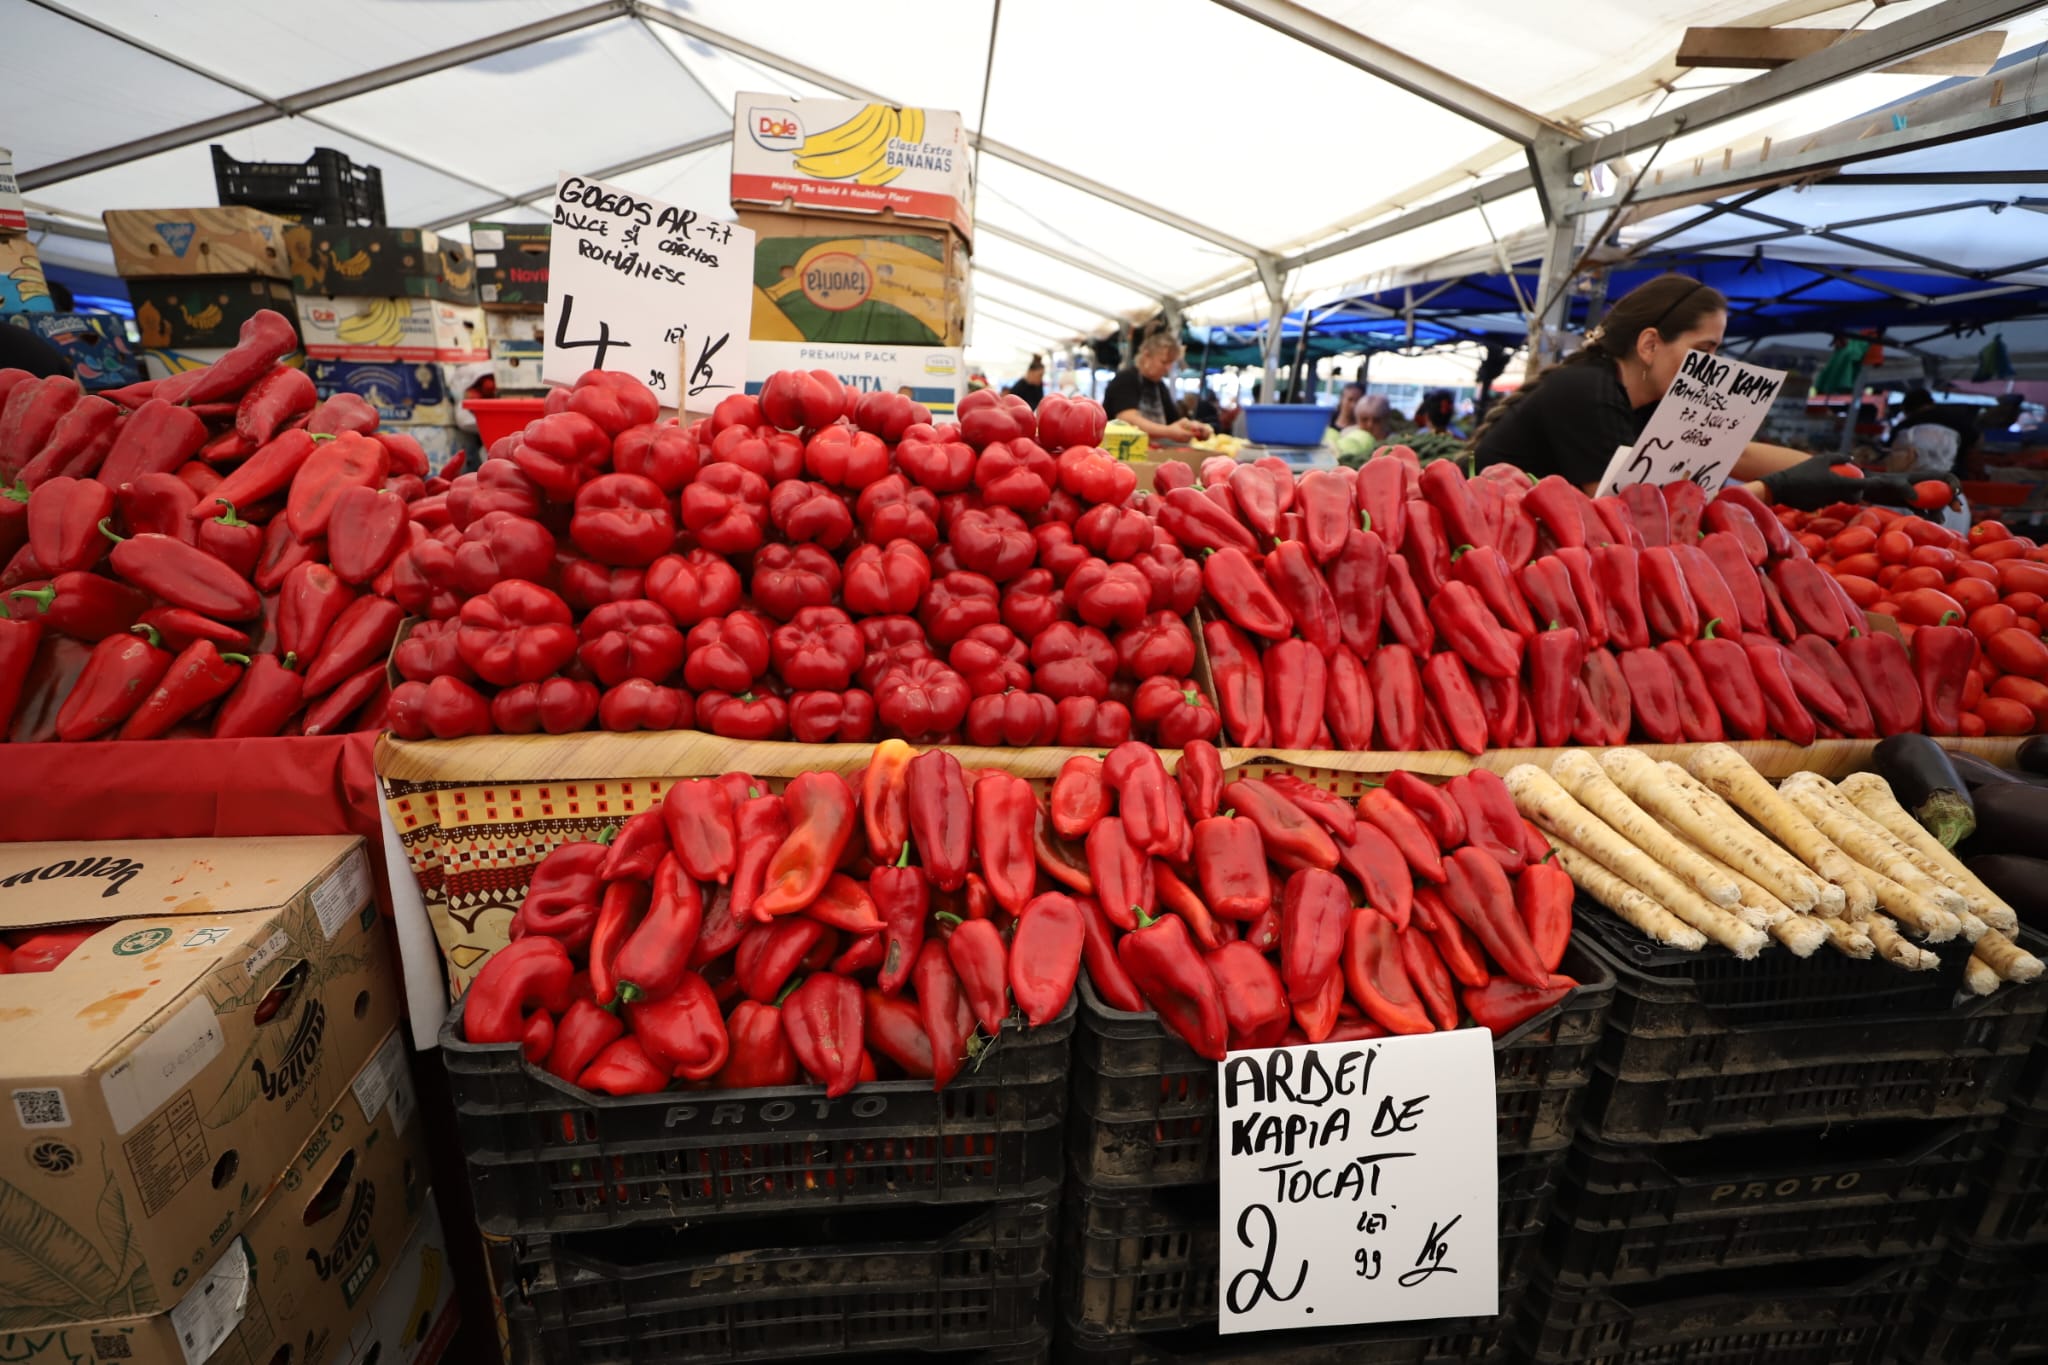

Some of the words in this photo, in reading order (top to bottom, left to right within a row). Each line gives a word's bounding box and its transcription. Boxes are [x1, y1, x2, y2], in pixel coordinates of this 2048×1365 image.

[760, 117, 797, 136] Dole
[887, 151, 952, 172] BANANAS
[888, 138, 918, 152] Class
[923, 143, 952, 157] Extra
[801, 183, 816, 194] The
[840, 187, 848, 196] A
[807, 268, 866, 298] favorita
[555, 294, 632, 370] 4
[800, 349, 860, 361] PREMIUM
[865, 351, 897, 362] PACK
[838, 374, 884, 395] NITA
[1224, 1043, 1383, 1108] ARDEI
[664, 1095, 888, 1128] PROTO
[1231, 1108, 1351, 1156] KAPIA
[1371, 1095, 1431, 1138] DE
[1258, 1152, 1417, 1203] TOCAT
[1711, 1171, 1862, 1201] PROTO
[1398, 1214, 1463, 1288] Kg
[347, 1252, 376, 1297] BIO
